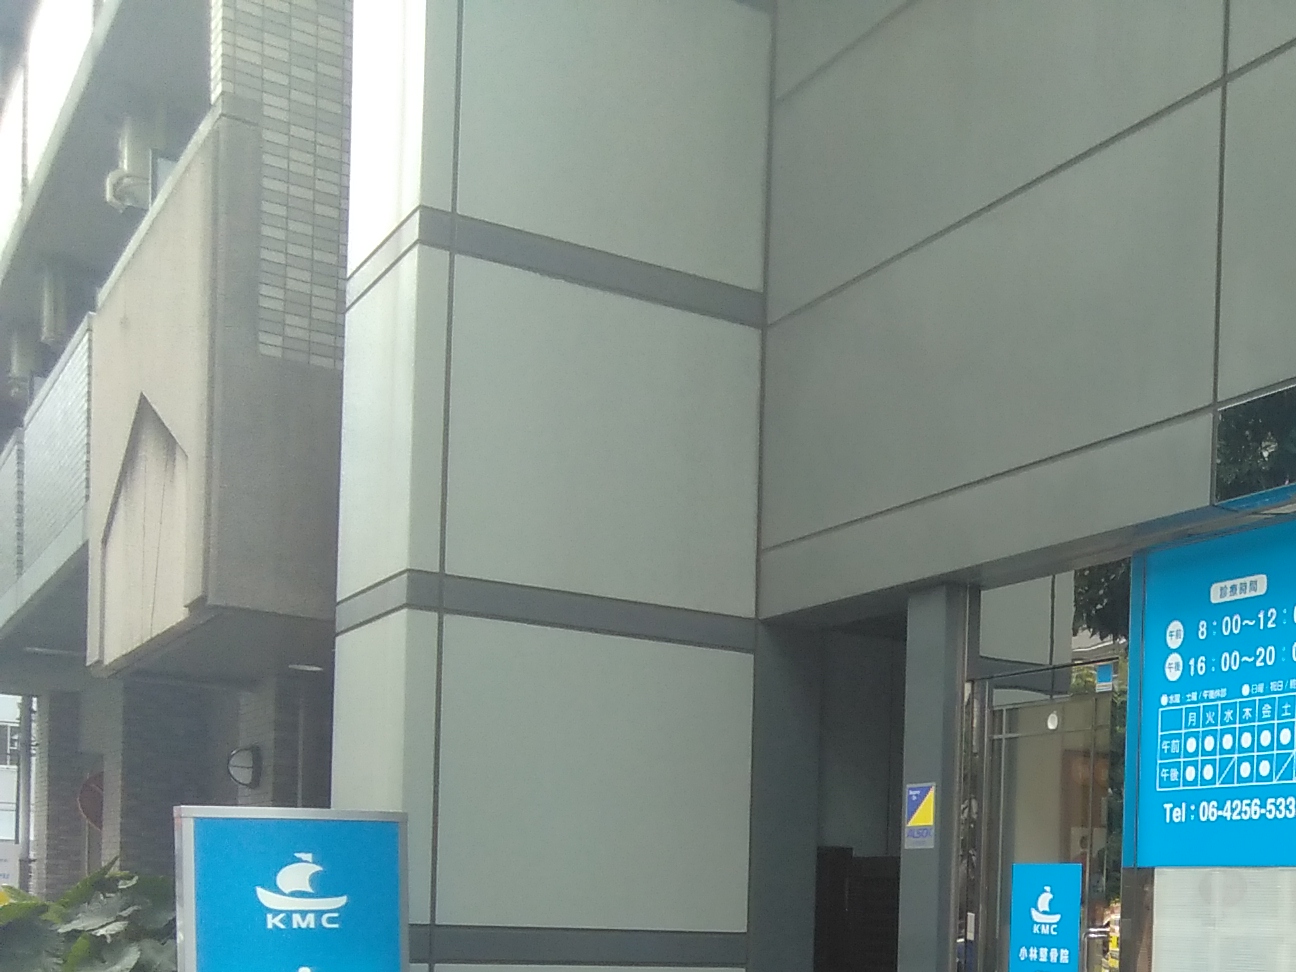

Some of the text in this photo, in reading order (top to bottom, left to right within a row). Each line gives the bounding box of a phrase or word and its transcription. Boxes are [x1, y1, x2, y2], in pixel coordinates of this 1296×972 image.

[1219, 579, 1258, 599] 診療時間
[1168, 628, 1183, 642] 午前
[1167, 660, 1182, 674] 午後
[1187, 712, 1197, 727] 月
[1205, 710, 1215, 725] 火
[1223, 709, 1234, 723] 水
[1242, 707, 1253, 720] 木
[1261, 704, 1272, 718] 金
[1281, 703, 1292, 717] 土
[1161, 739, 1181, 754] 午前
[1160, 767, 1179, 782] 午後
[266, 912, 341, 929] KMC
[1033, 924, 1058, 935] KMC
[1019, 946, 1070, 964] 小林整骨院
